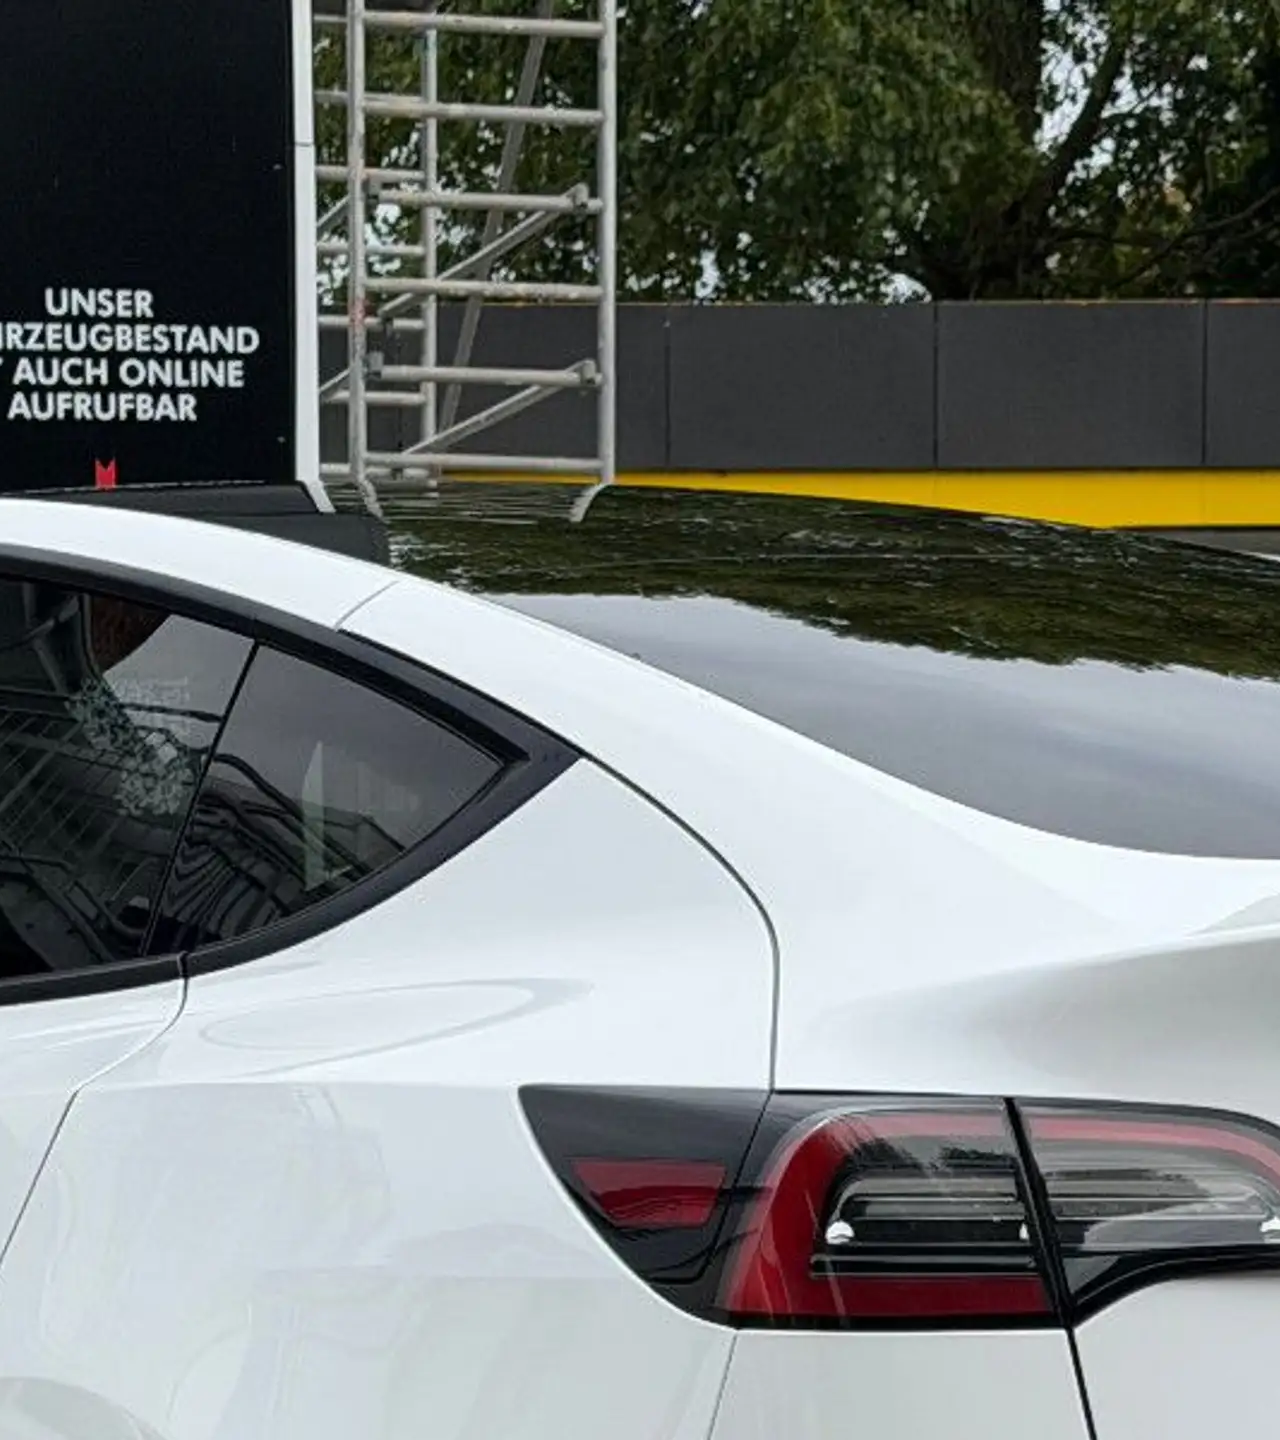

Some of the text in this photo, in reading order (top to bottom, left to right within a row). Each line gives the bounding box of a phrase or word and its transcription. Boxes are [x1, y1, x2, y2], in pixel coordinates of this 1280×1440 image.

[46, 288, 153, 317] UNSER
[13, 358, 109, 387] AUCH
[119, 359, 245, 388] ONLINE
[7, 392, 197, 421] AUFRUFBAR
